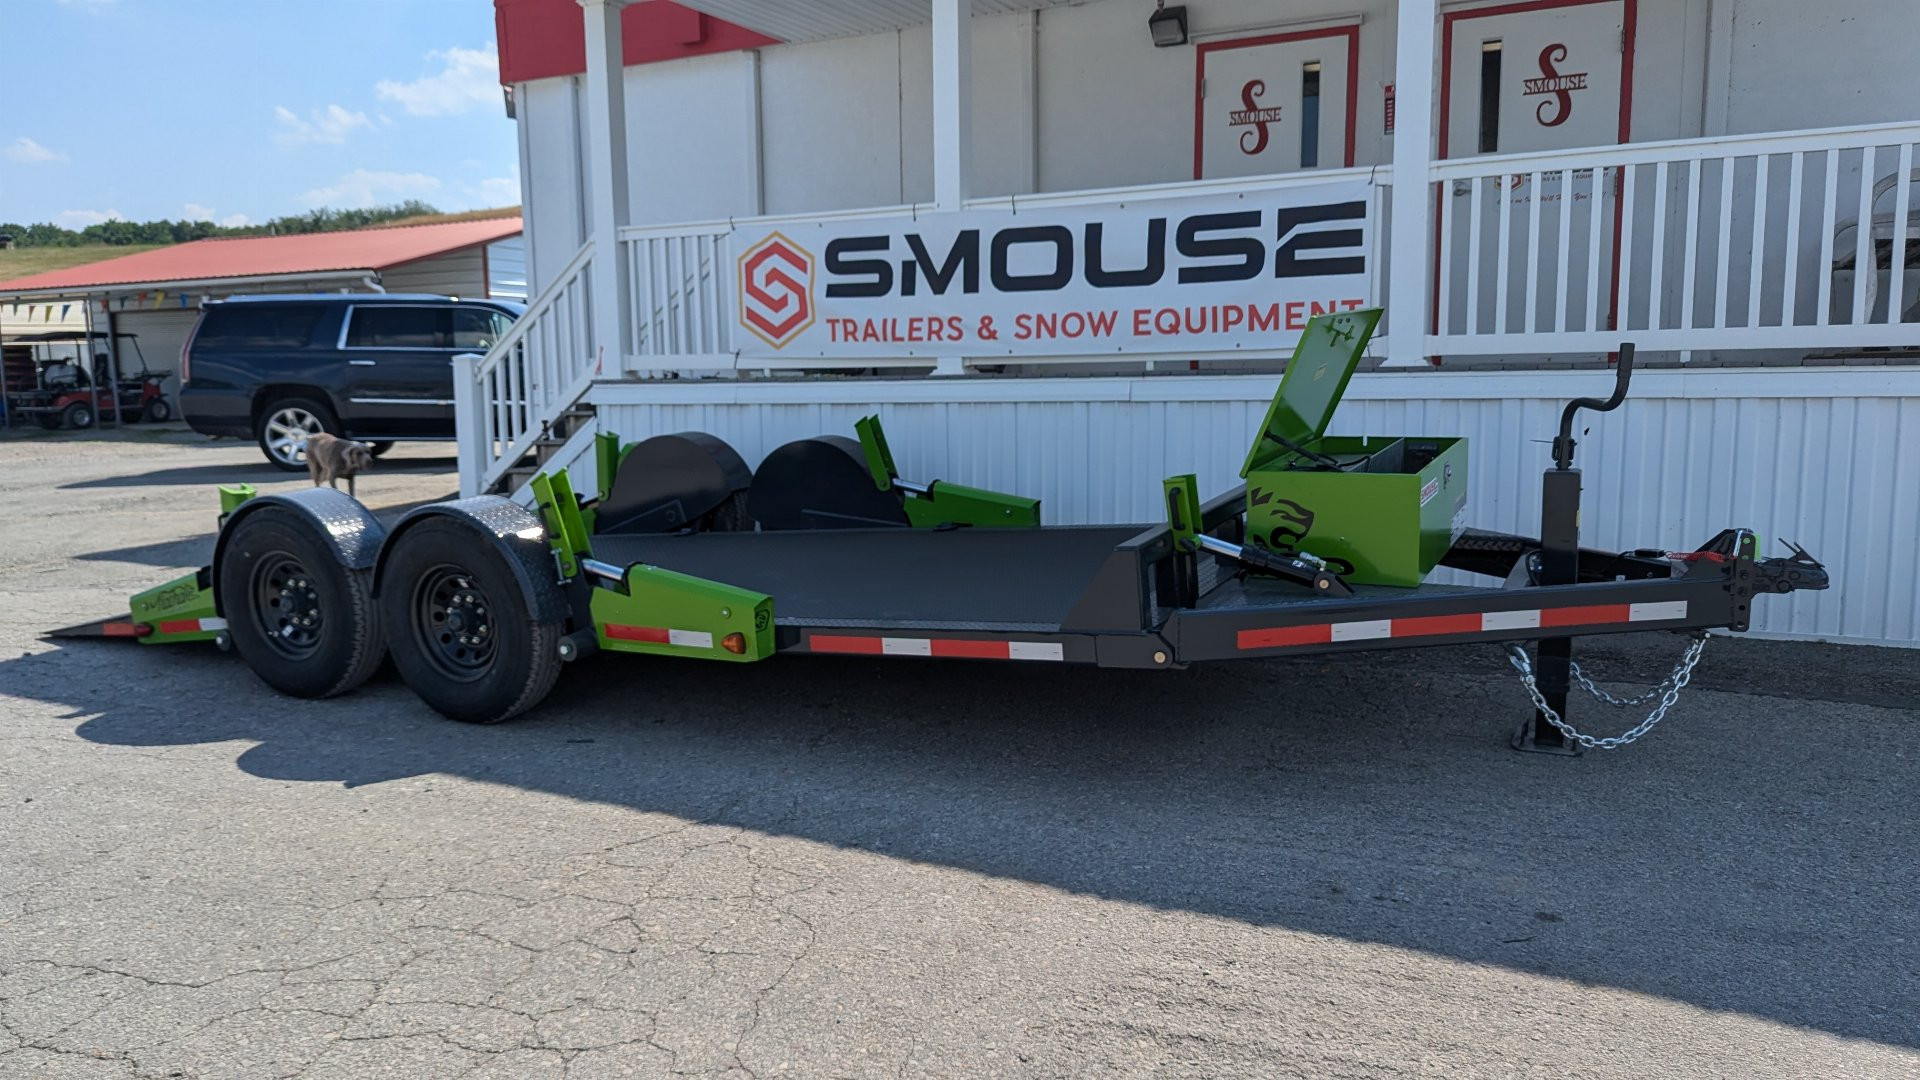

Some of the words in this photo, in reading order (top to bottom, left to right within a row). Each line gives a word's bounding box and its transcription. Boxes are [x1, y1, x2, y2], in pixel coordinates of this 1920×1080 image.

[1523, 73, 1587, 95] SMOUSE
[1229, 107, 1281, 126] SMOUSE
[825, 200, 1366, 298] SMOUSE
[826, 316, 963, 342] TRAILERS
[977, 315, 998, 341] &
[1014, 310, 1118, 340] SNOW
